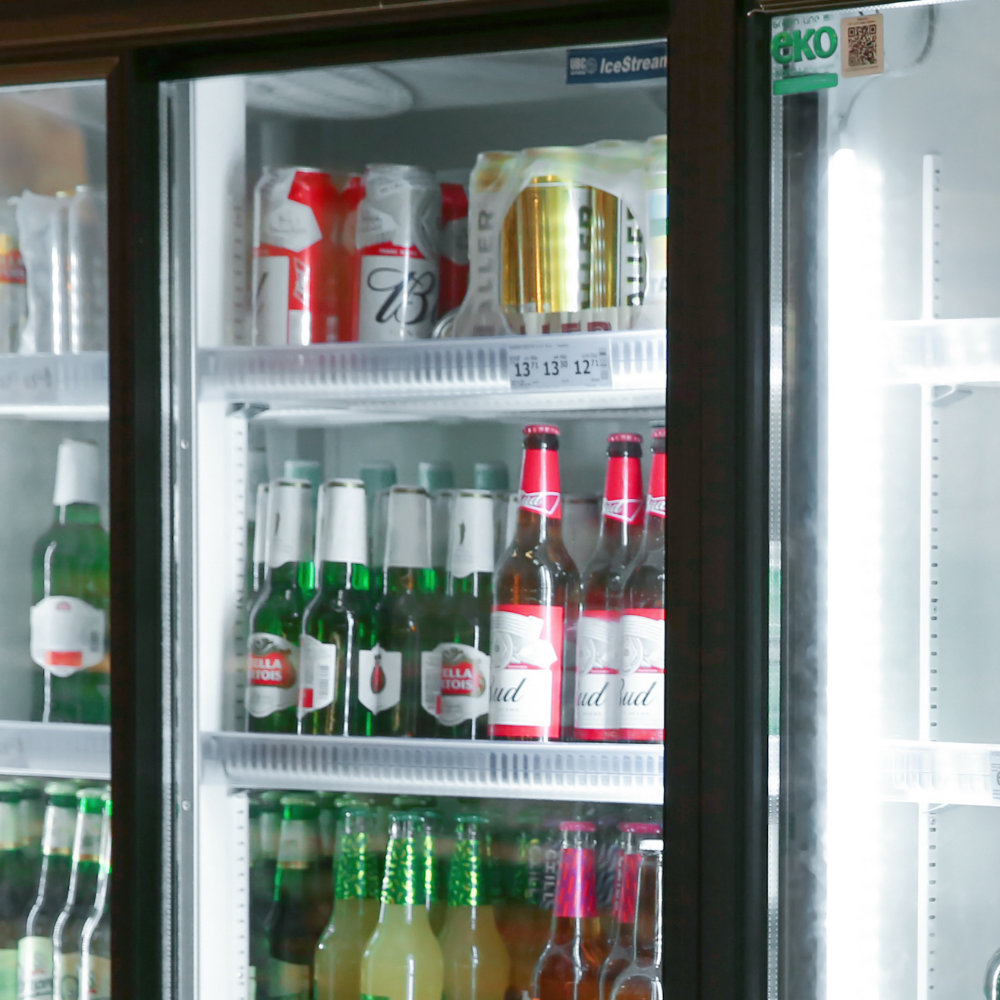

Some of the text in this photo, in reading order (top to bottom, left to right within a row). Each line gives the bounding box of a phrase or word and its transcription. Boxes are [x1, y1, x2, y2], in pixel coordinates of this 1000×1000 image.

[770, 26, 838, 64] eko
[250, 657, 283, 670] ELLA
[249, 670, 283, 682] TOIS
[441, 667, 474, 680] ELLA
[490, 678, 526, 704] ud
[577, 682, 610, 708] ud
